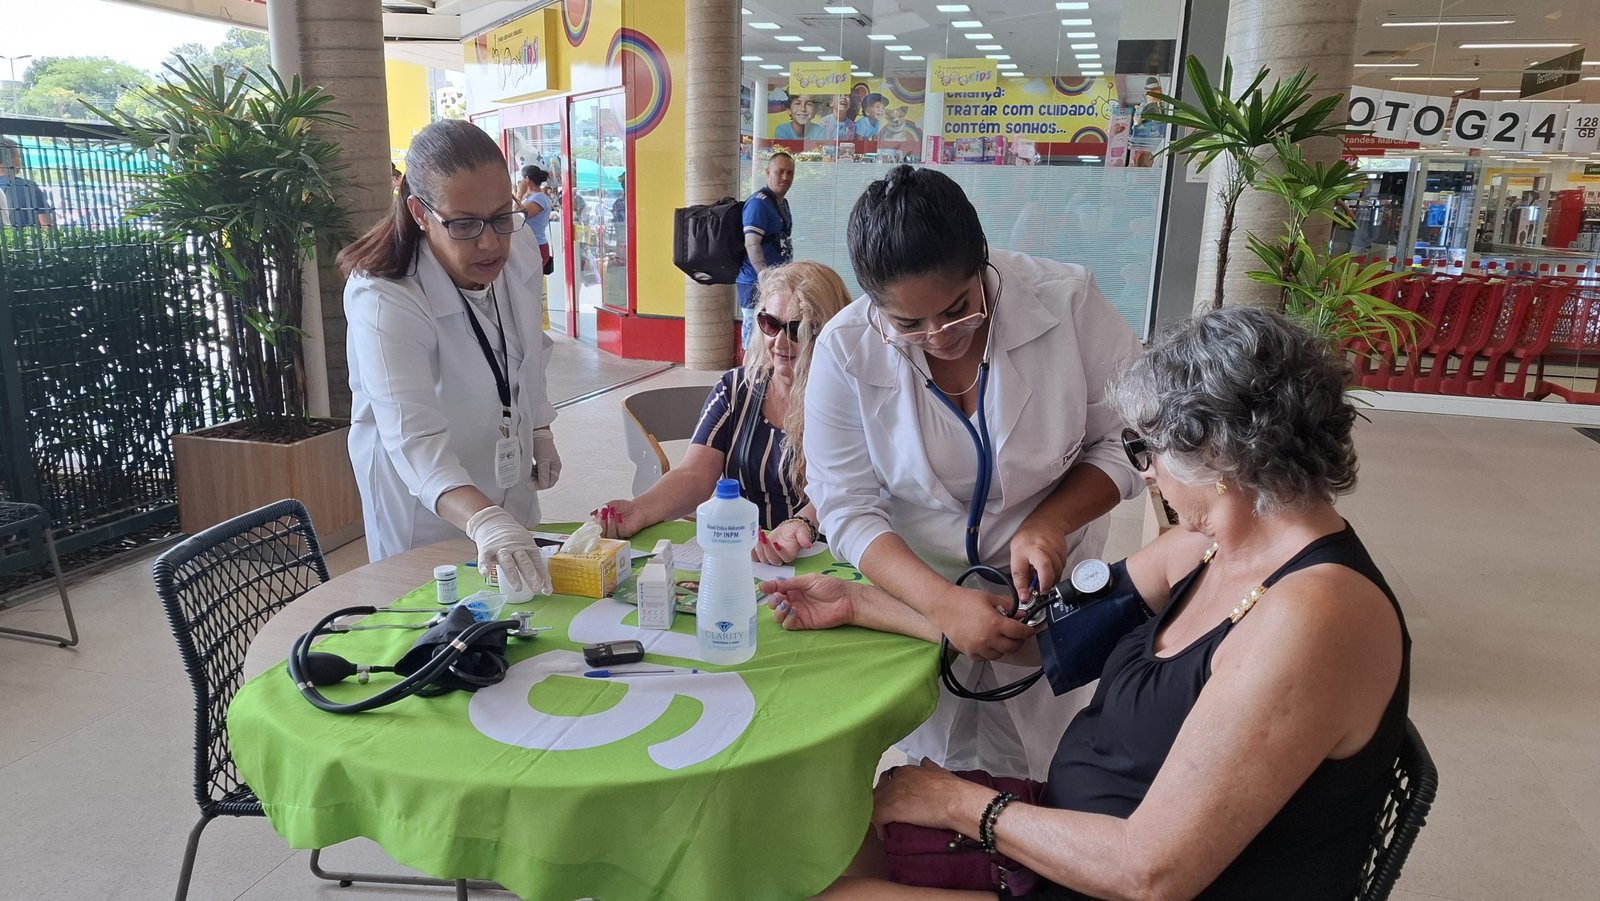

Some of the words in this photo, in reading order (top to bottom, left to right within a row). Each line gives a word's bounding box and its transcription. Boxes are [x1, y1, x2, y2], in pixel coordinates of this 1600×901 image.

[1575, 116, 1600, 128] 128
[1577, 128, 1597, 139] GB
[1344, 136, 1376, 145] randes
[723, 531, 739, 539] INPM
[705, 630, 744, 640] CLARITY
